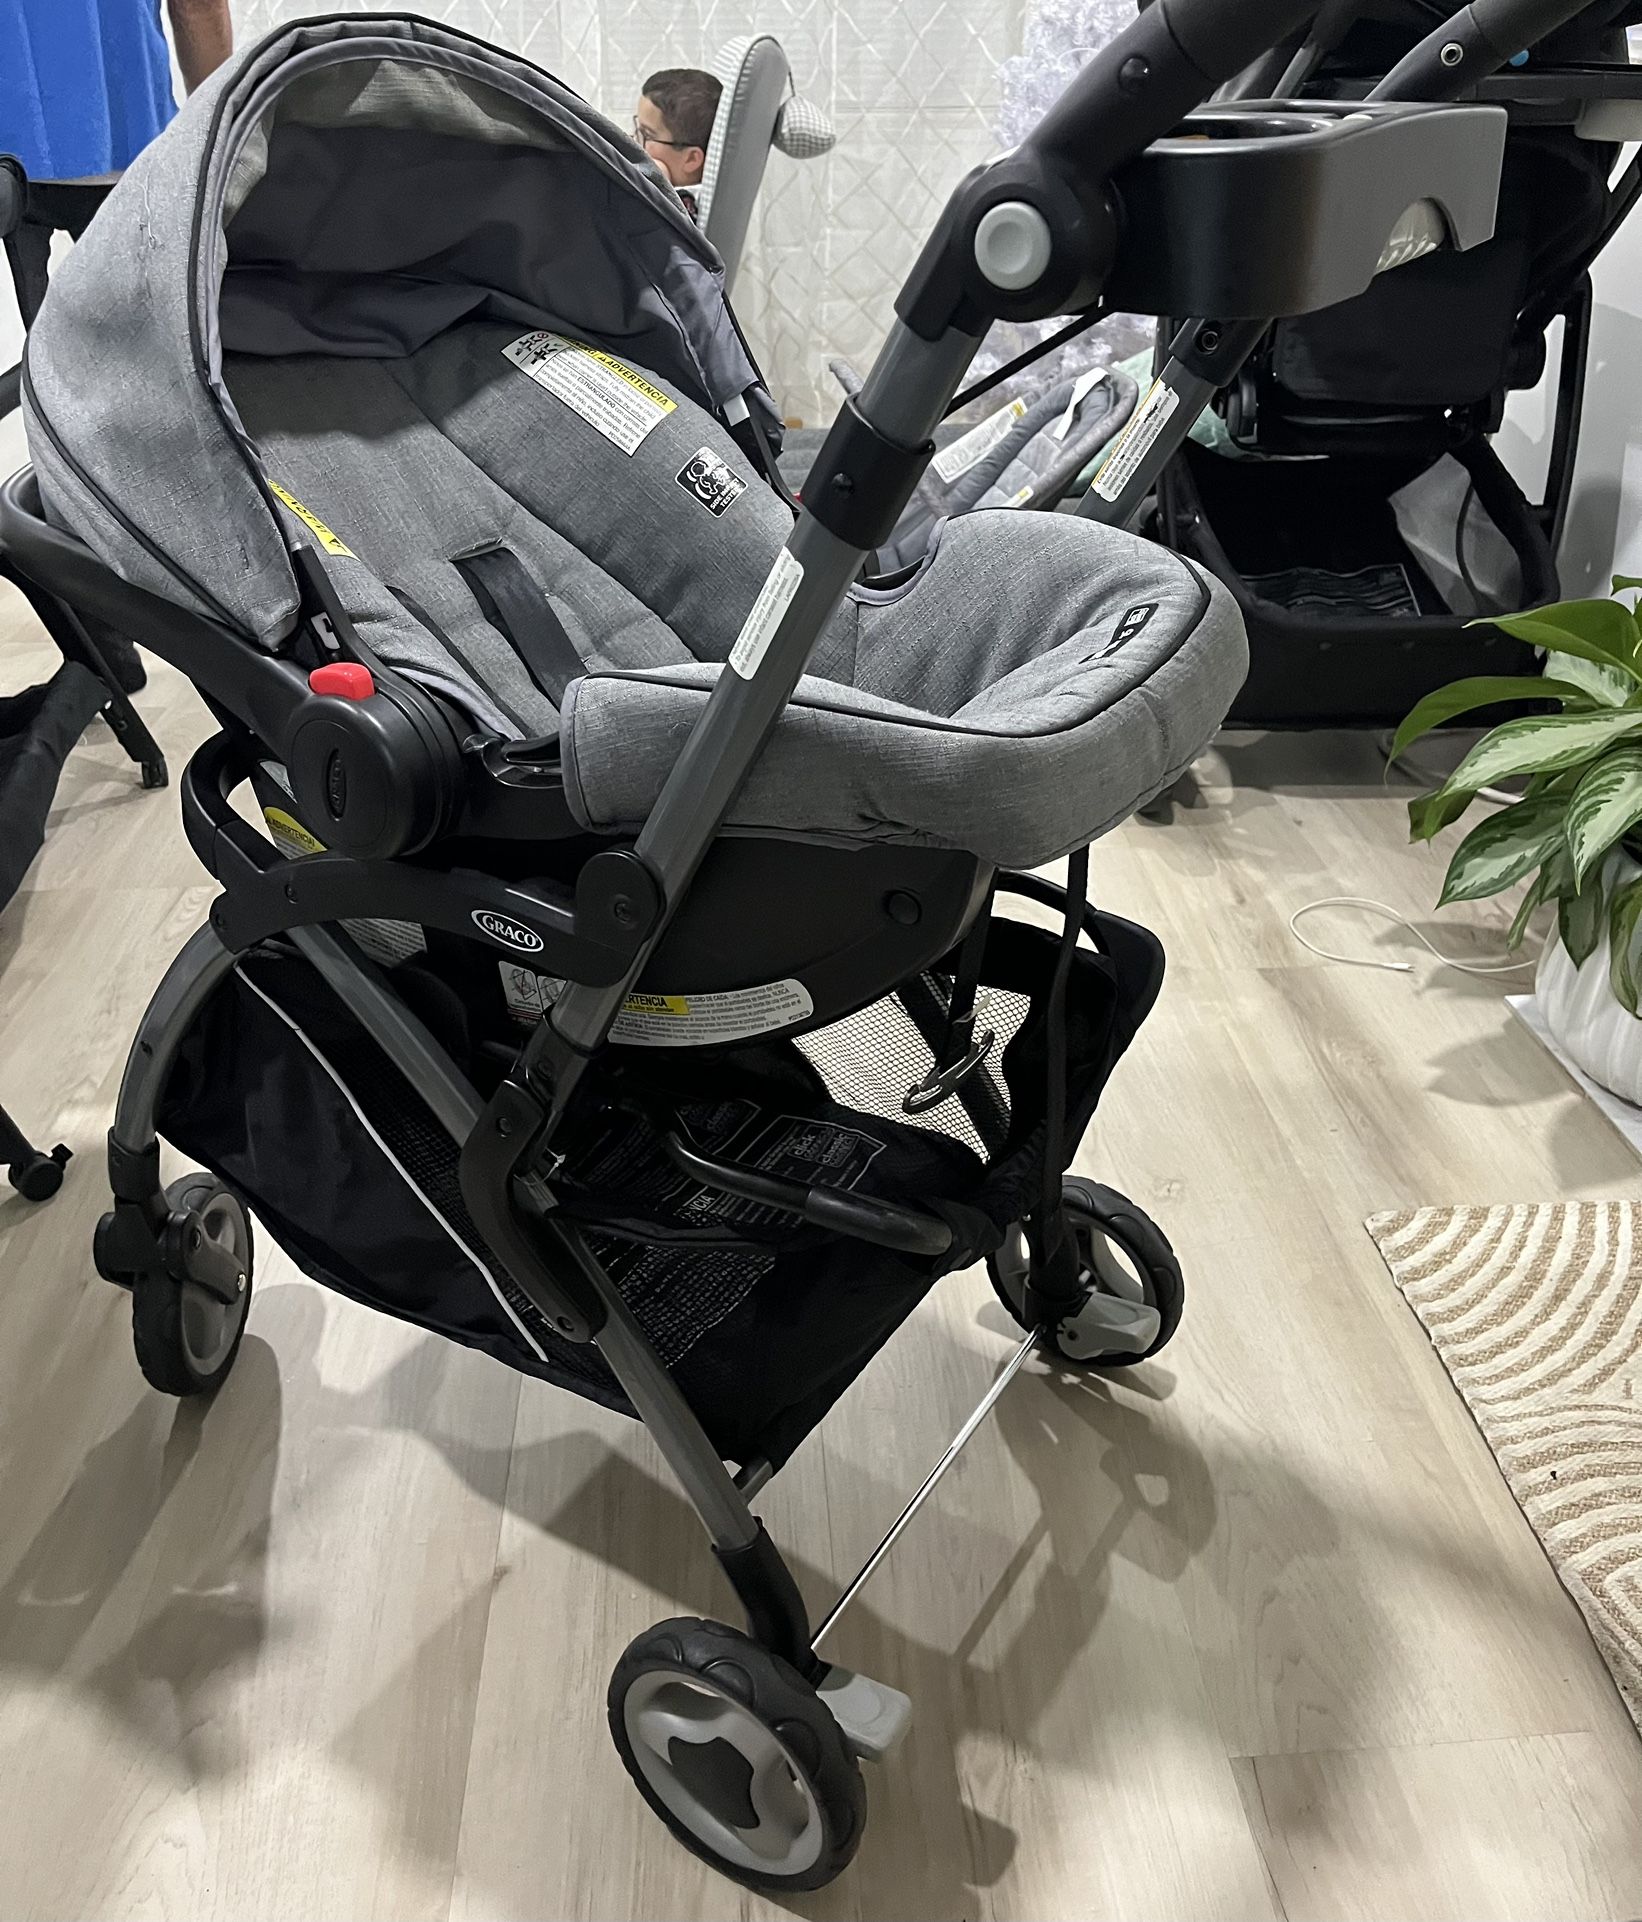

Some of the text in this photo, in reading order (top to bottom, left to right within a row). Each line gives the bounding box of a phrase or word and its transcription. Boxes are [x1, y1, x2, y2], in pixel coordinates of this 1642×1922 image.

[576, 376, 616, 408] ESTRANGULADO
[605, 359, 668, 406] ADVERTENCIA
[709, 495, 722, 509] SIDE
[482, 915, 537, 947] GRACO
[625, 994, 668, 1007] RTENCIA
[791, 1135, 815, 1156] click
[821, 1132, 848, 1162] classic
